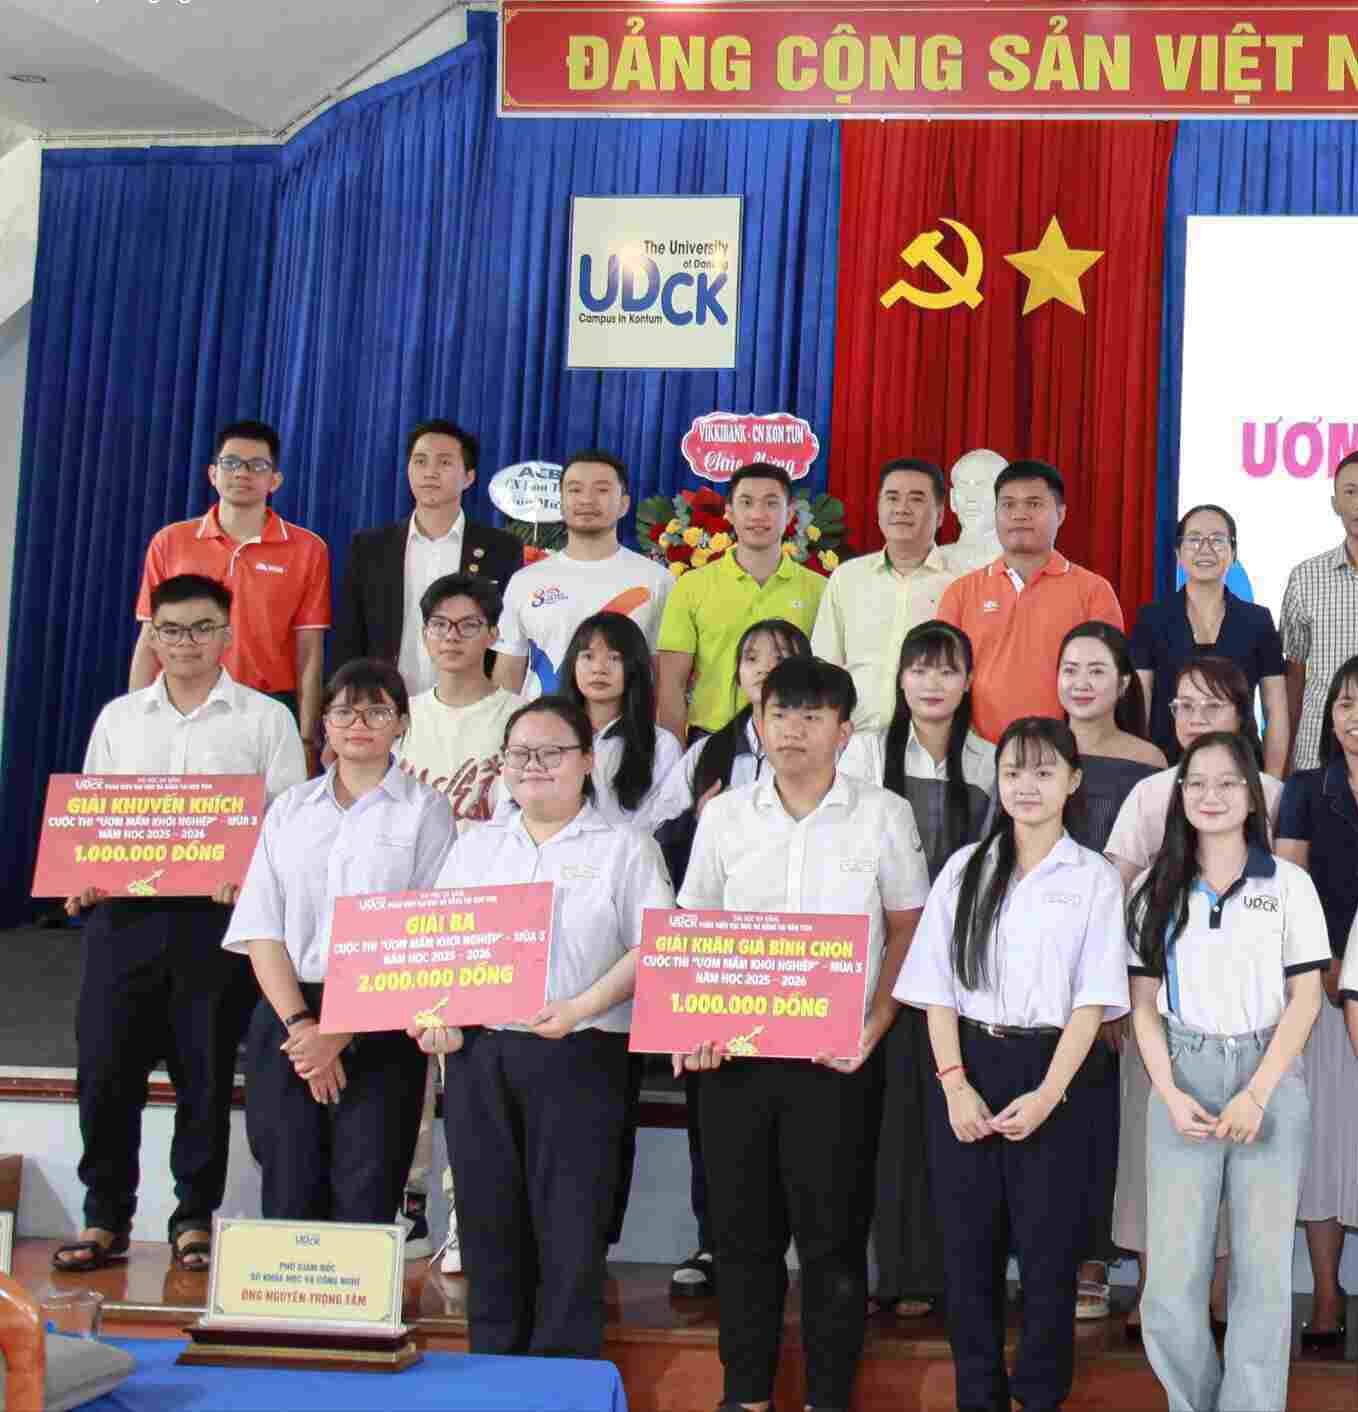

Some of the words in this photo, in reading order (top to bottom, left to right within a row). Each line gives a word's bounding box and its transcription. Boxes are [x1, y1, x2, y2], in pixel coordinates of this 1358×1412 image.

[567, 16, 752, 91] ĐẢNG
[776, 23, 963, 104] CỘNG
[988, 15, 1130, 91] SẢN
[1155, 22, 1303, 104] VIỆT
[644, 239, 666, 255] The
[669, 239, 728, 256] University
[683, 259, 692, 268] of
[579, 254, 729, 326] UDCK
[579, 313, 617, 325] Campus
[629, 313, 663, 324] Kontum
[66, 793, 107, 814] GIẢI
[111, 792, 185, 814] KHUYẾN
[190, 794, 244, 814] KHÍCH
[74, 845, 167, 862] 1.000.000
[171, 840, 225, 862] ĐỒNG
[406, 911, 444, 935] GIẢI
[449, 911, 476, 932] BA
[656, 934, 689, 953] GIẢI
[356, 968, 454, 993] 2.000.000
[459, 960, 513, 987] ĐỒNG
[745, 975, 770, 985] 2025
[672, 991, 768, 1015] 1.000.000
[773, 991, 829, 1017] ĐỒNG
